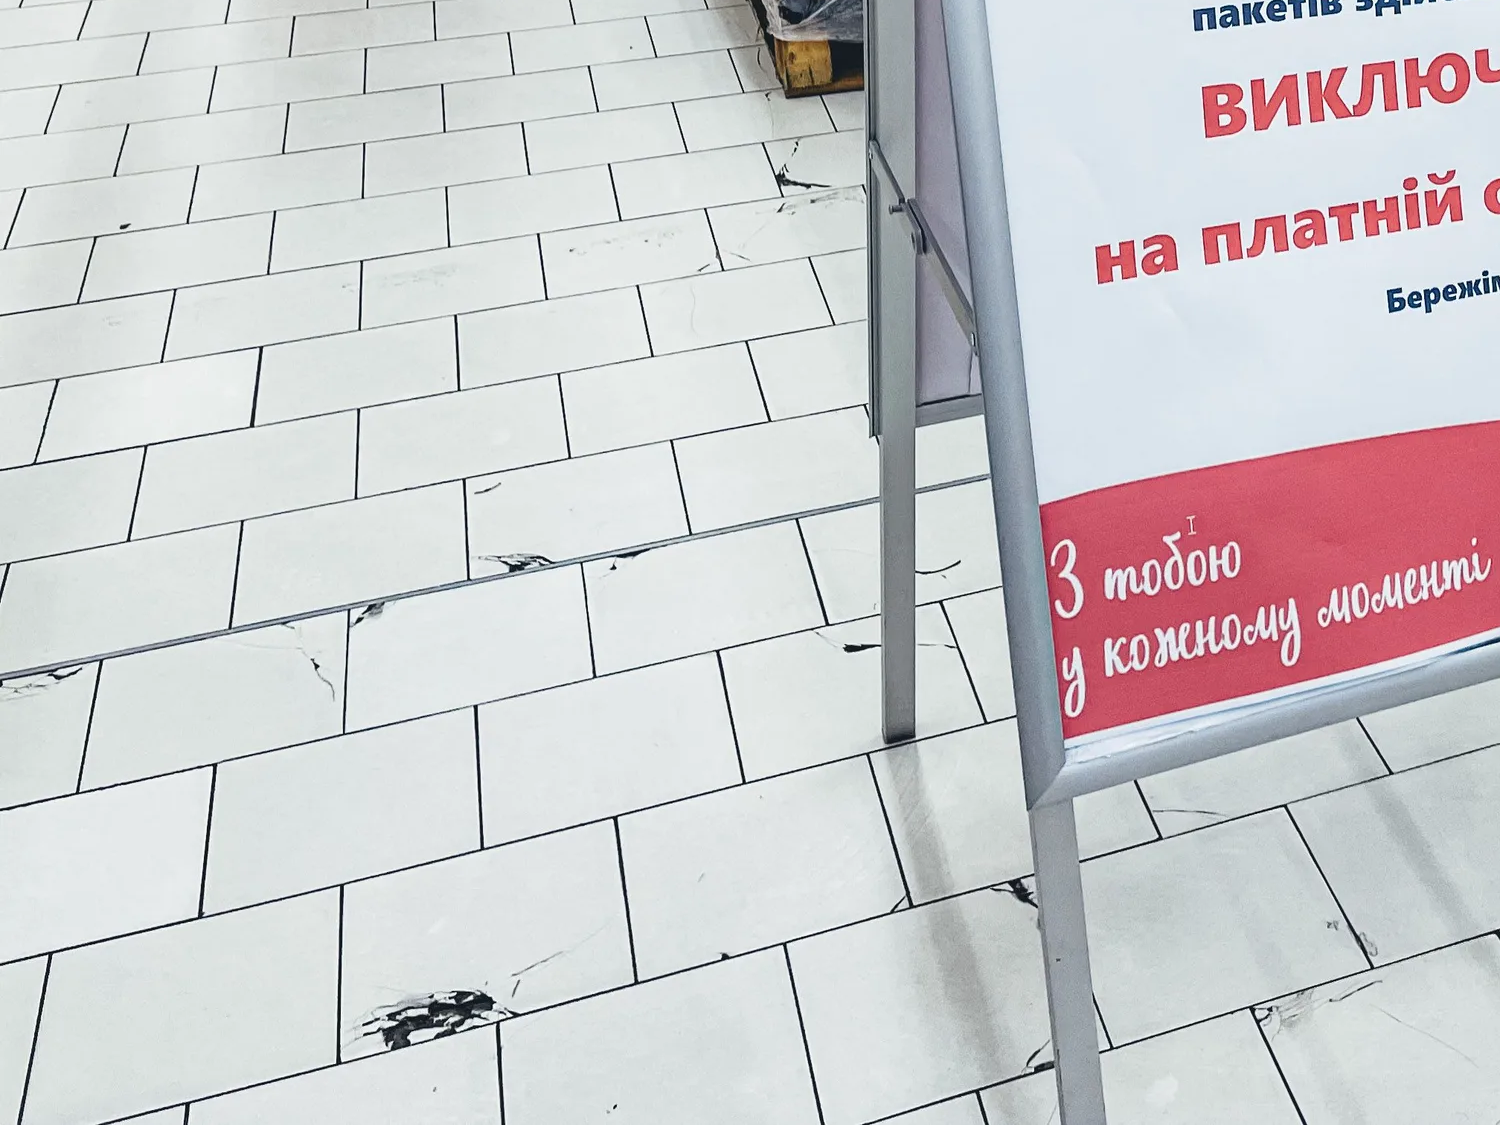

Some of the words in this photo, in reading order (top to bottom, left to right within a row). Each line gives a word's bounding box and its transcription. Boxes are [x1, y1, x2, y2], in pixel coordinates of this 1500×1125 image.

[1095, 234, 1179, 285] на
[1201, 169, 1464, 265] платній
[1104, 531, 1241, 601] тобою
[1061, 646, 1086, 718] у
[1103, 604, 1302, 668] кожному
[1317, 537, 1492, 628] моменті
